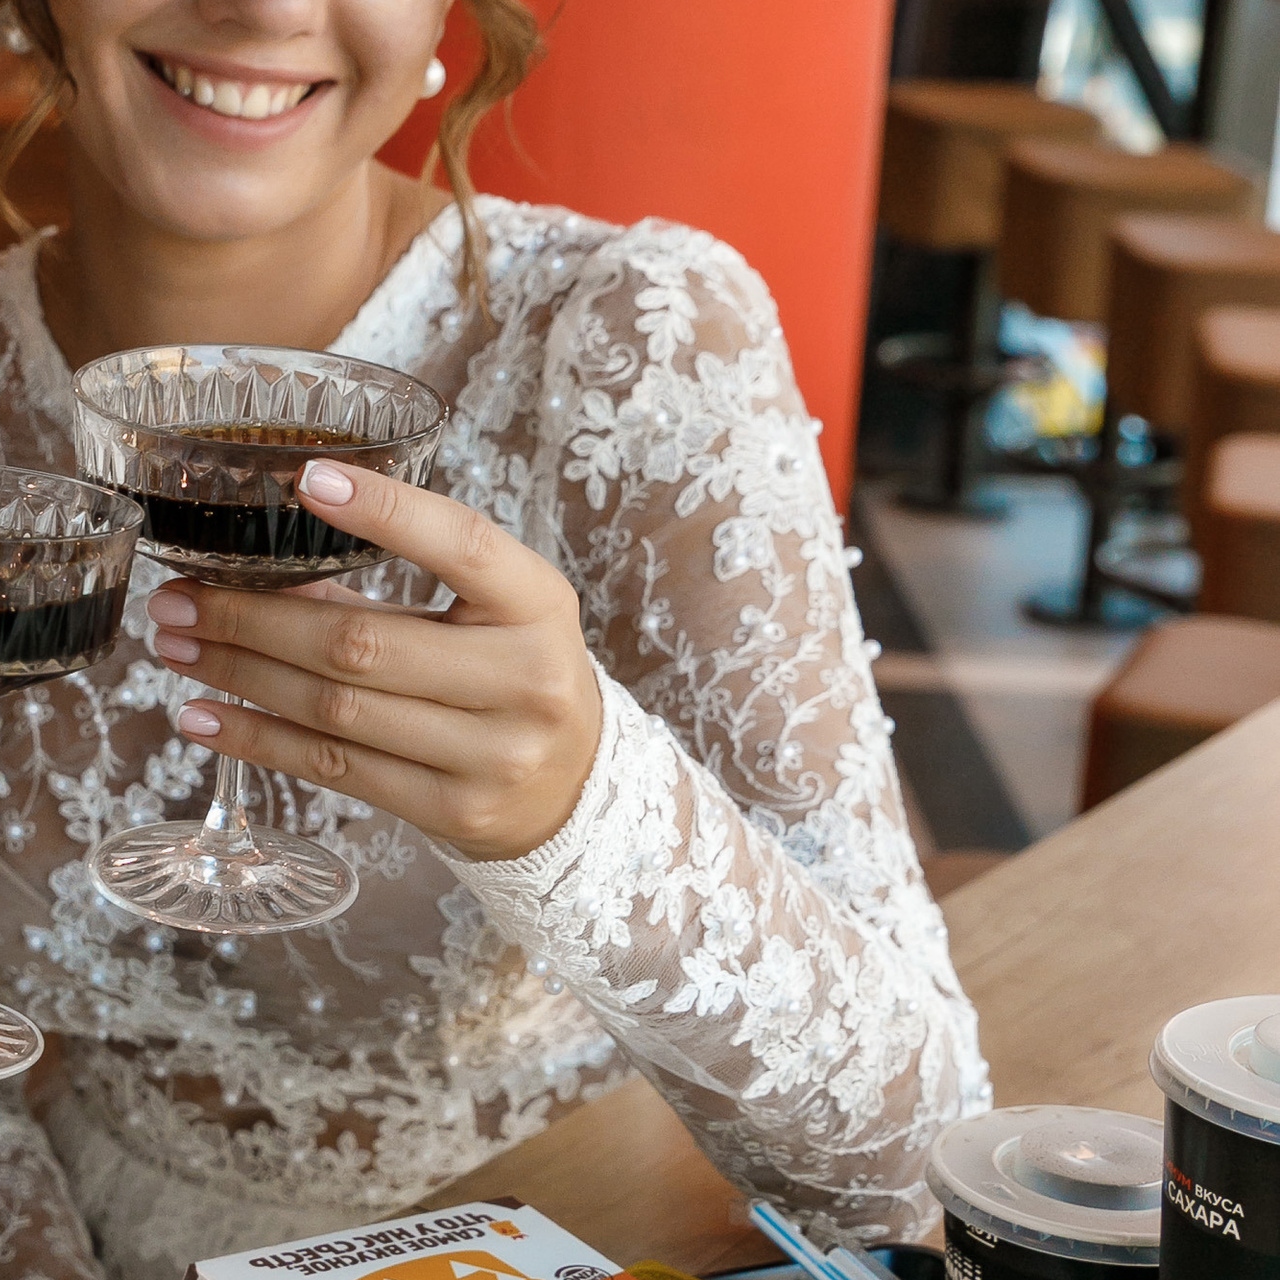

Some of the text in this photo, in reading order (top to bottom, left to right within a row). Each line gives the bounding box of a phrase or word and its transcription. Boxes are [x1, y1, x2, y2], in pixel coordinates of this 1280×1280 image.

[1168, 1181, 1240, 1241] САХАРА
[1195, 1184, 1245, 1218] ВКУСА
[248, 1212, 495, 1270] ЧТО У НАС СЪЕСТЬ
[286, 1227, 486, 1277] САМОЕ ВКУСНОЕ,
